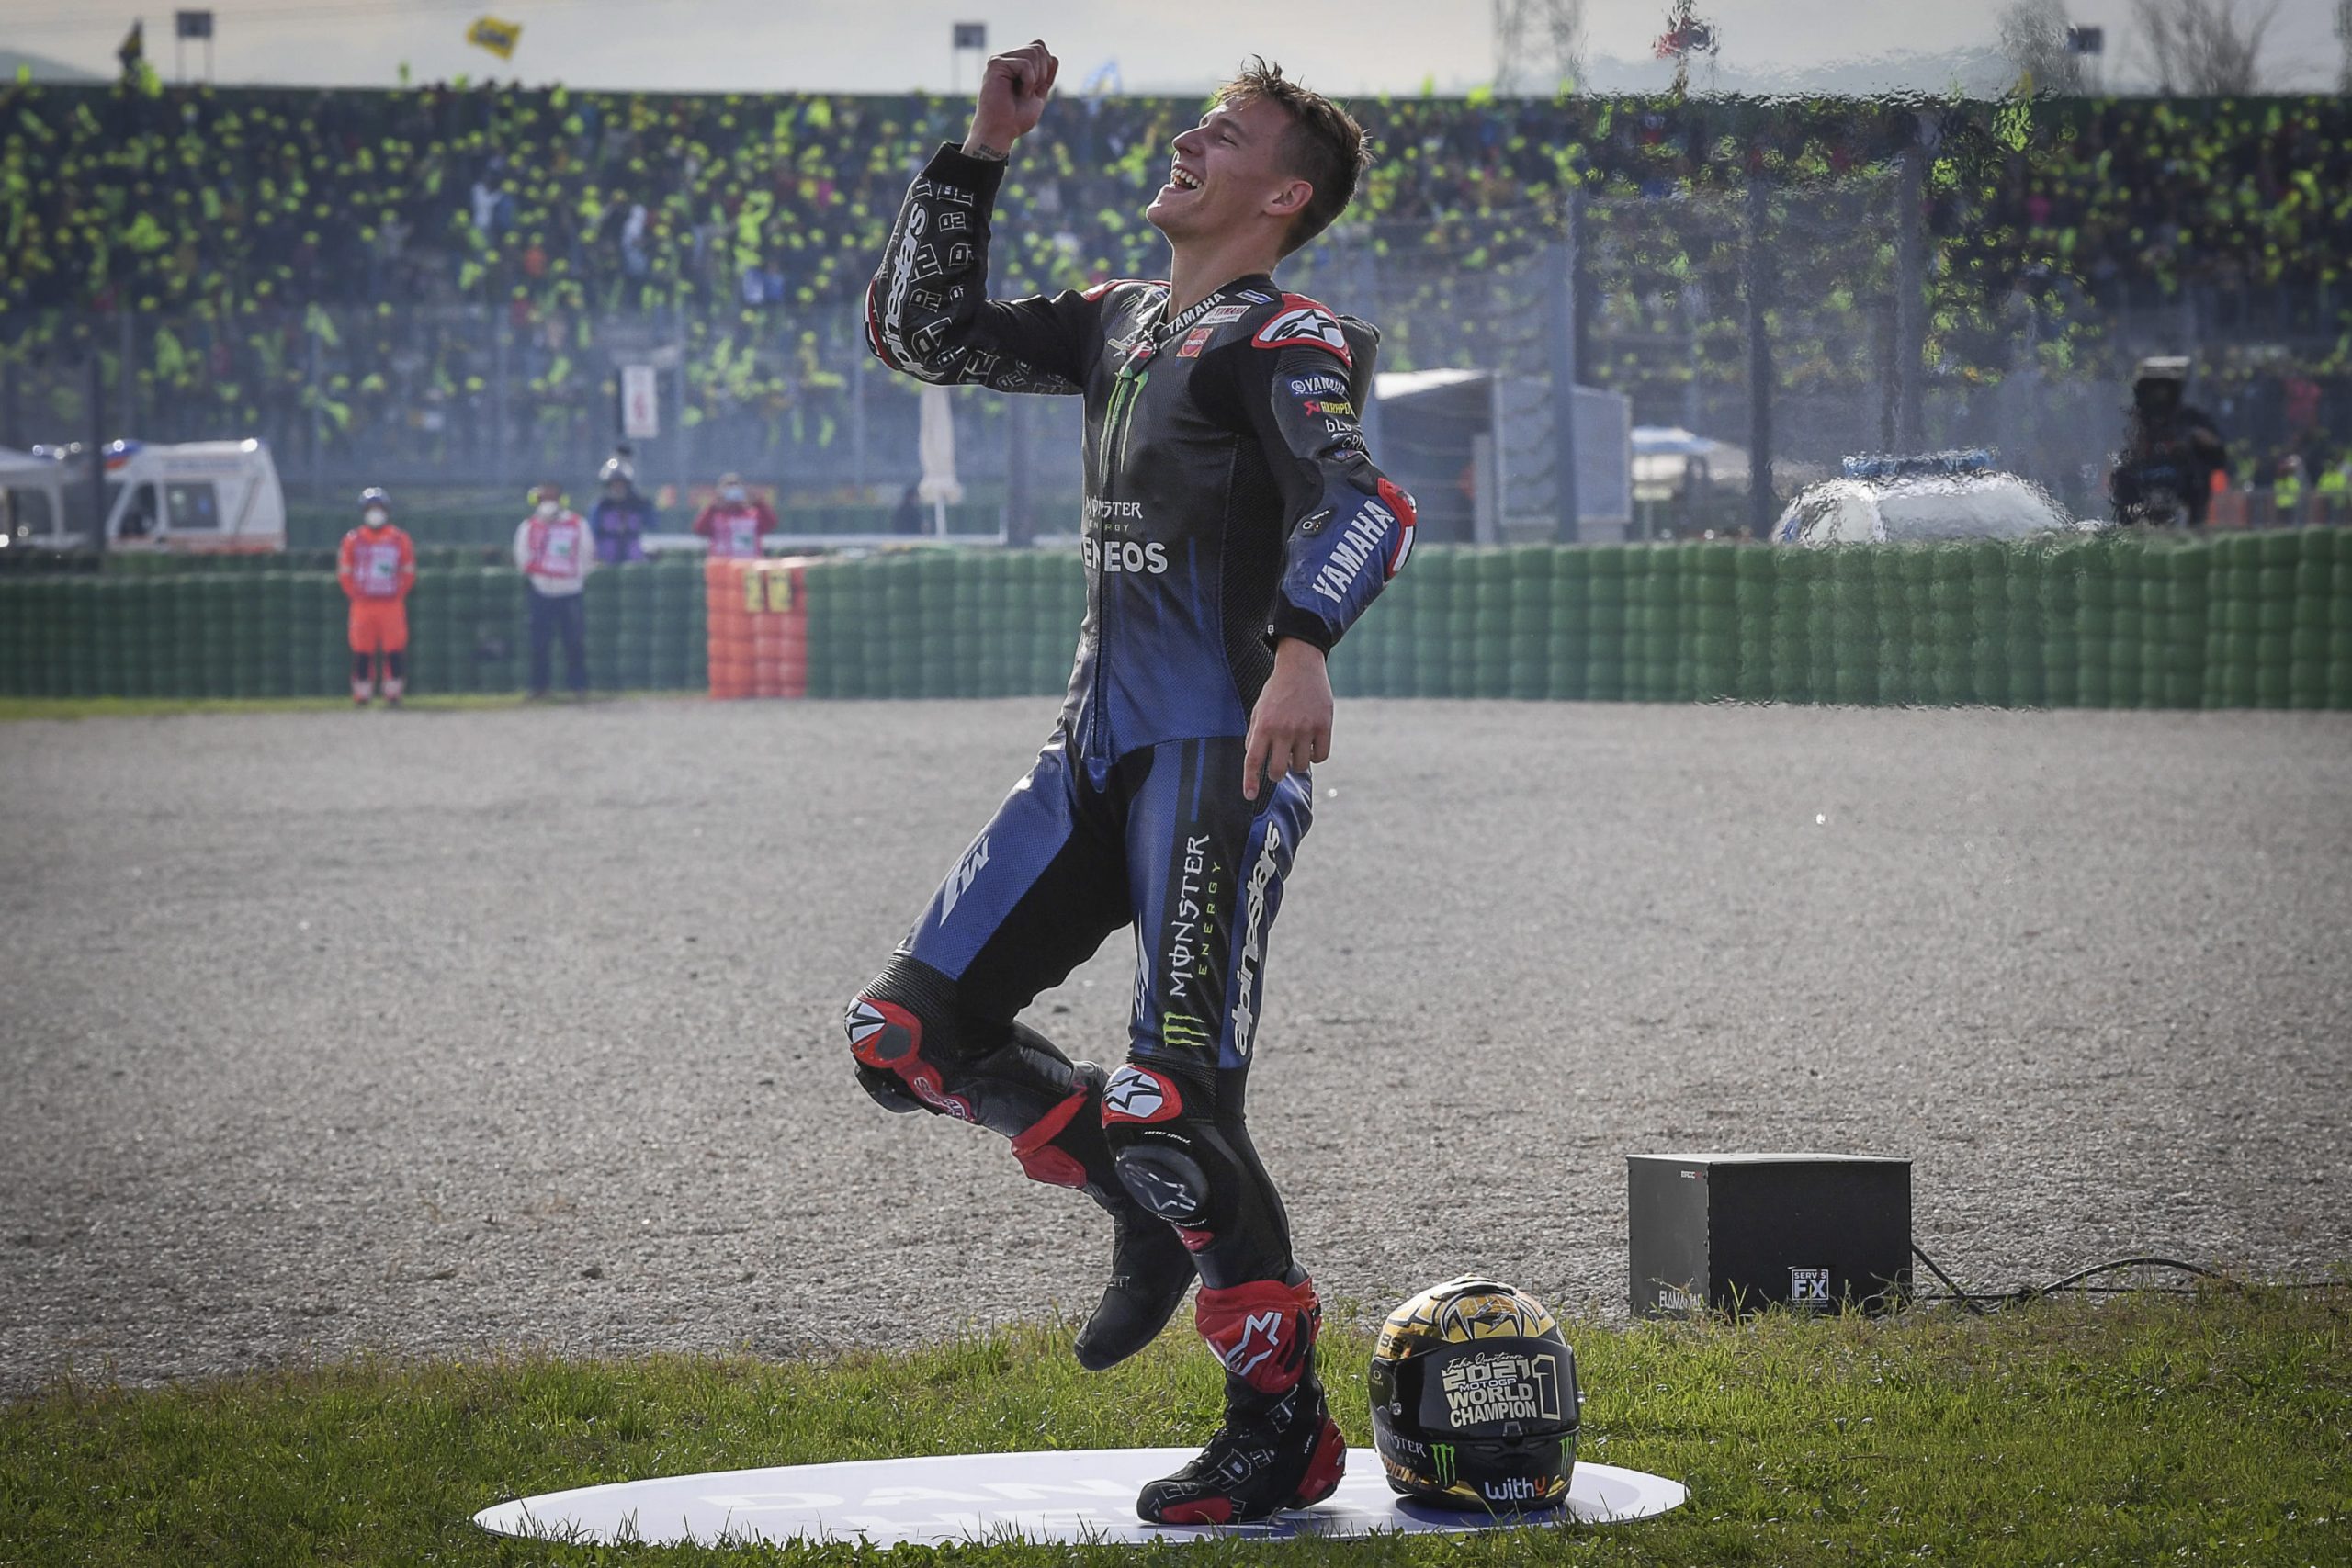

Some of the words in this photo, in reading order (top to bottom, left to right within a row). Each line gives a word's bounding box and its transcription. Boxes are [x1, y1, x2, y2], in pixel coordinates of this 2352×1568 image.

[1168, 292, 1227, 335] YAMAHA
[1089, 519, 1129, 532] ENRGY
[1082, 536, 1168, 574] ENEOS
[1312, 500, 1396, 604] YAMAHA
[1169, 834, 1210, 998] MONSTER
[1198, 861, 1221, 976] ENERGY
[1232, 821, 1280, 1056] alpinestars
[1794, 1280, 1826, 1297] FX
[1442, 1359, 1531, 1392] 2021
[1446, 1383, 1534, 1410] WORLD
[1450, 1400, 1538, 1428] CHAMPION
